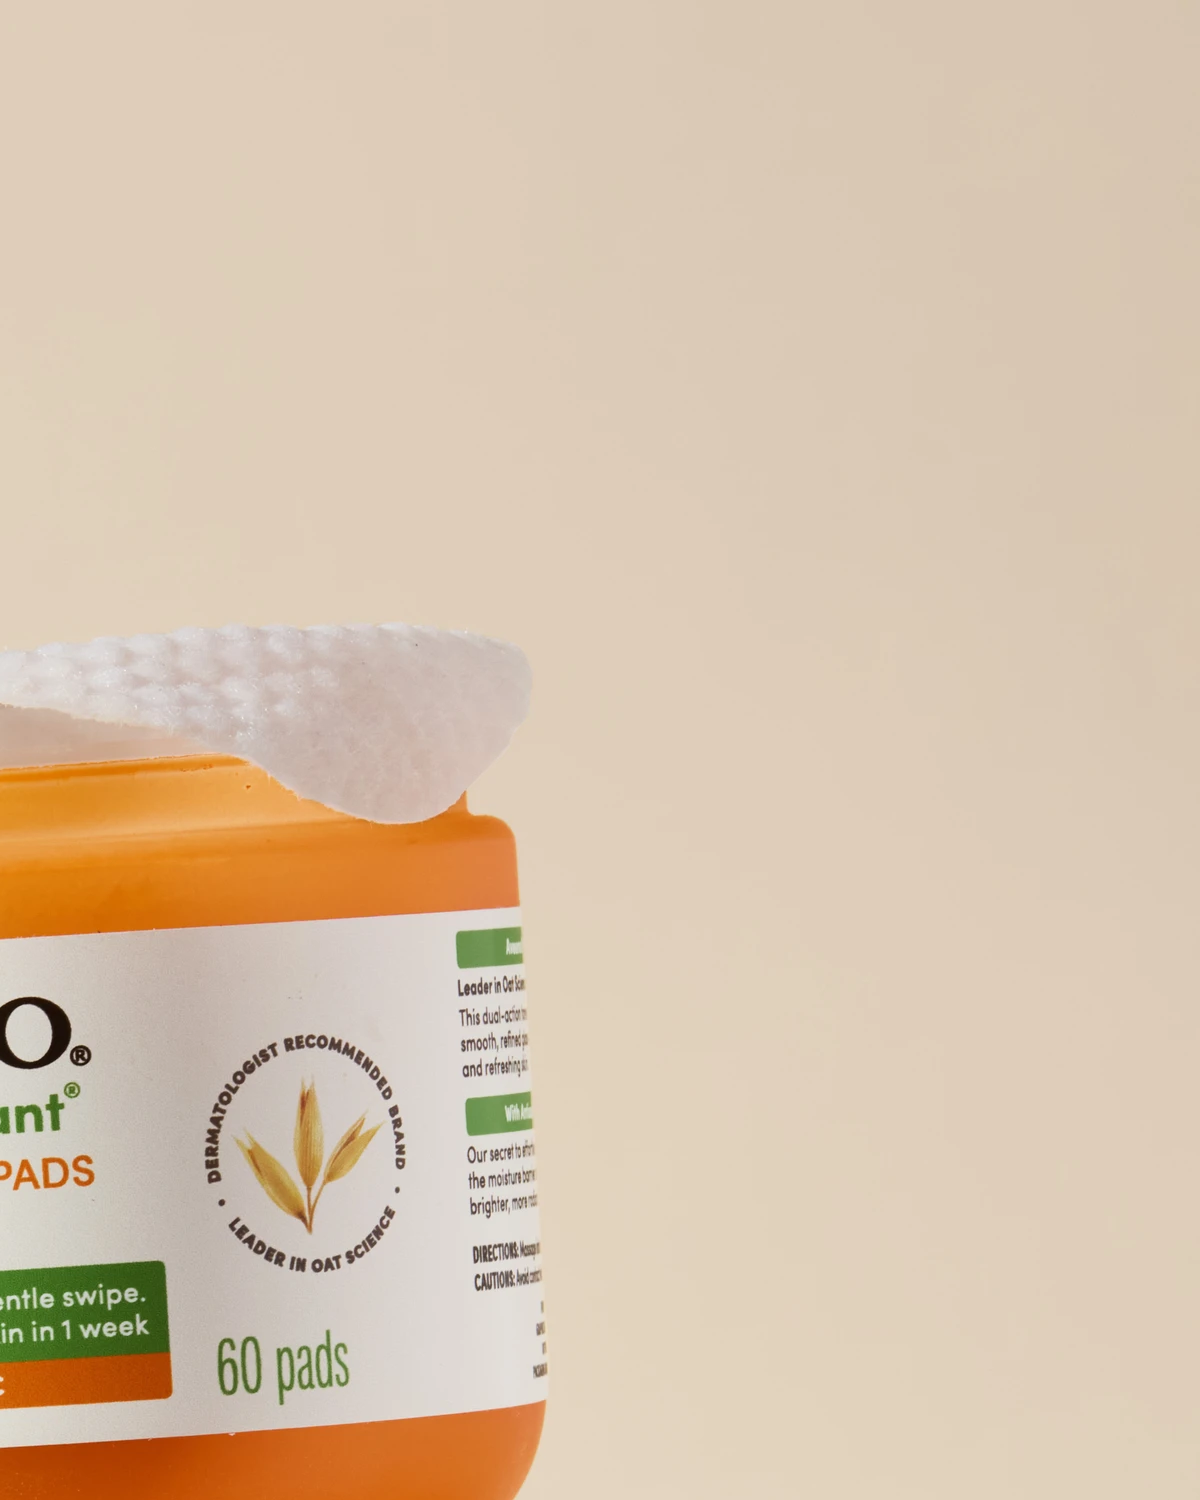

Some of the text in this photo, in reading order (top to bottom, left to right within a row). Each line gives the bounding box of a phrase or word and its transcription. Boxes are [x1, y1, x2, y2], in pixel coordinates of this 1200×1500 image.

[457, 976, 492, 997] Leader
[494, 976, 502, 994] in
[502, 975, 513, 993] Oat
[459, 1008, 480, 1027] This
[483, 1004, 521, 1025] dual-action
[461, 1032, 499, 1052] smooth,
[500, 1030, 521, 1049] refined
[462, 1057, 483, 1078] and
[485, 1056, 521, 1077] refreshing
[204, 1034, 406, 1184] DERMATOLOGIST RECOMMENDED BRAND
[466, 1146, 487, 1164] Our
[489, 1145, 514, 1163] secret
[515, 1144, 522, 1160] to
[468, 1171, 486, 1189] the
[488, 1168, 522, 1187] moisture
[469, 1196, 511, 1219] brighter,
[511, 1194, 527, 1213] more
[228, 1205, 396, 1274] LEADER IN OAT SCIENCE
[472, 1241, 519, 1264] DIRECTIONS:
[474, 1269, 516, 1291] CAUTIONS:
[62, 1282, 147, 1313] swipe.
[31, 1320, 55, 1342] in
[62, 1319, 73, 1341] 1
[79, 1313, 150, 1339] week
[217, 1329, 350, 1406] 60 pads
